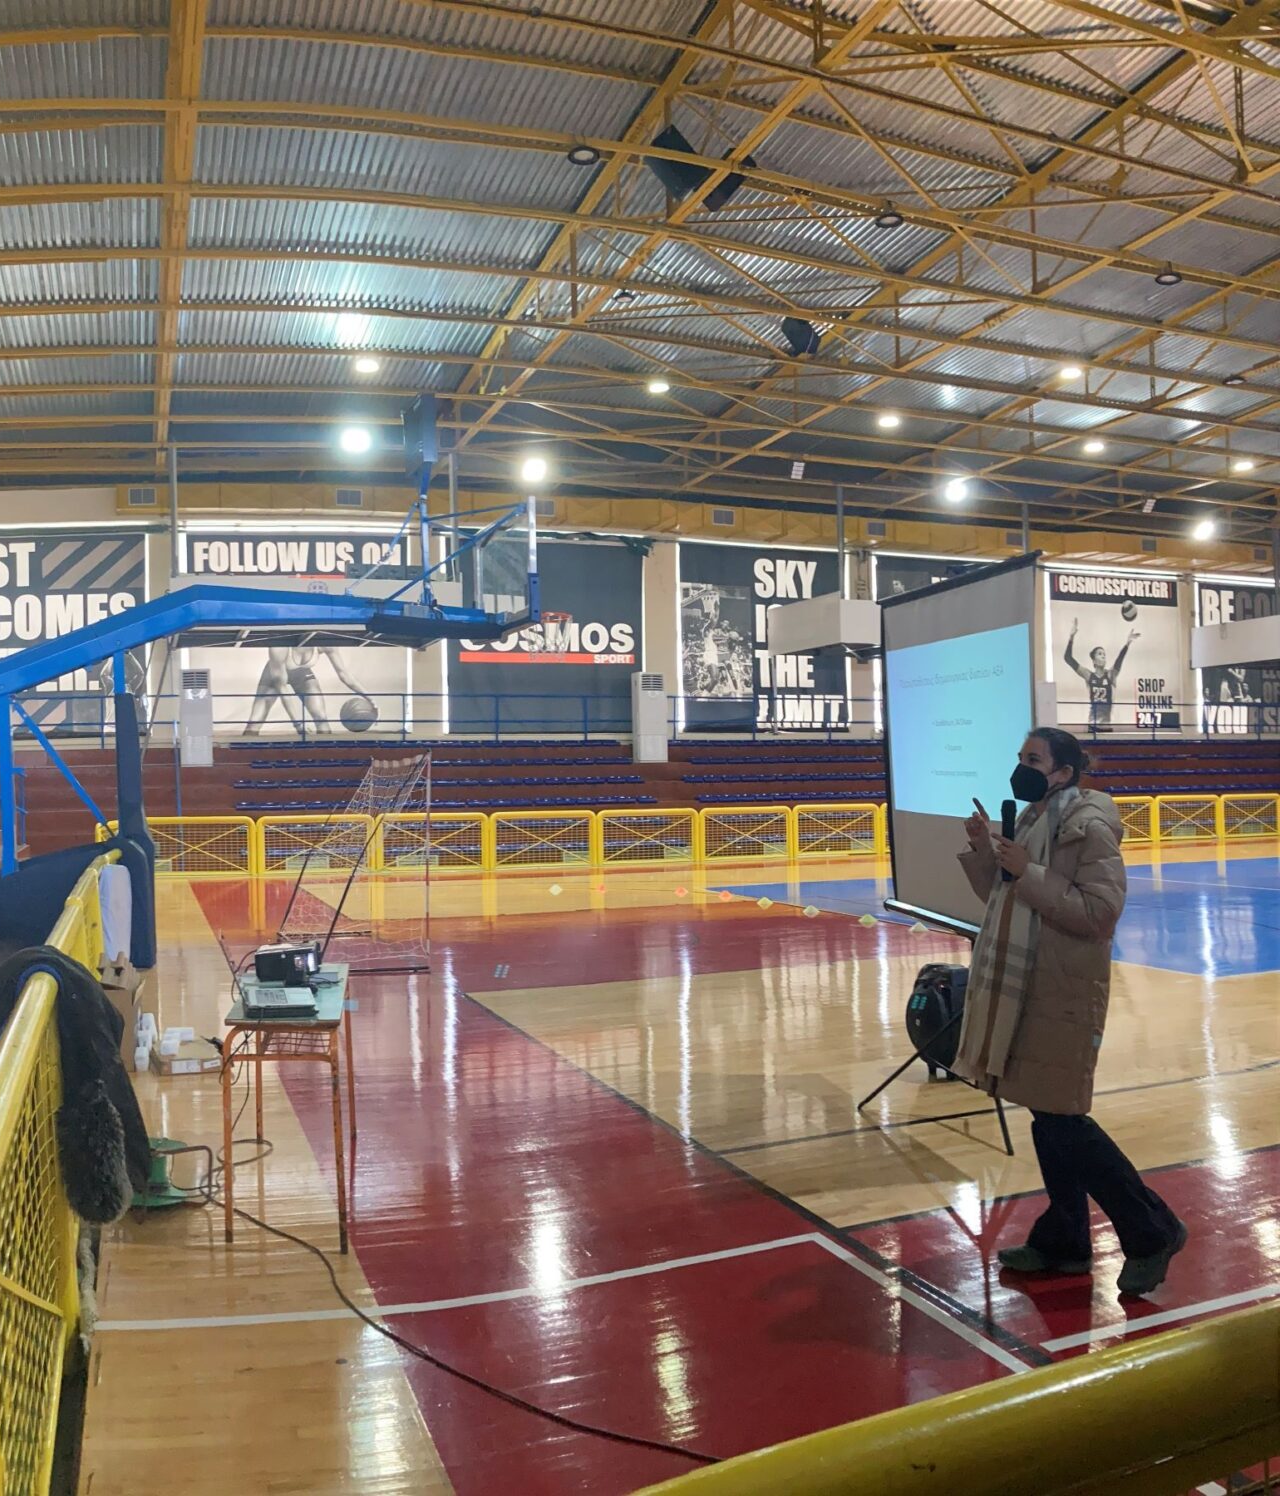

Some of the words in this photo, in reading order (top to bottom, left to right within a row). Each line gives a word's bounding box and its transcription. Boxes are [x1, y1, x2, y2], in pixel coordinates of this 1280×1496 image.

[194, 541, 309, 572] FOLLOW
[315, 542, 355, 573] US
[754, 558, 817, 599] SKY
[1058, 575, 1169, 599] COSMOSSPORT.GR
[755, 603, 784, 643] I
[593, 653, 632, 664] SPORT
[755, 650, 815, 688] THE
[1092, 686, 1107, 702] 22
[1137, 678, 1165, 693] SHOP
[1138, 694, 1173, 710] ONLINE
[1203, 705, 1280, 734] YOURS
